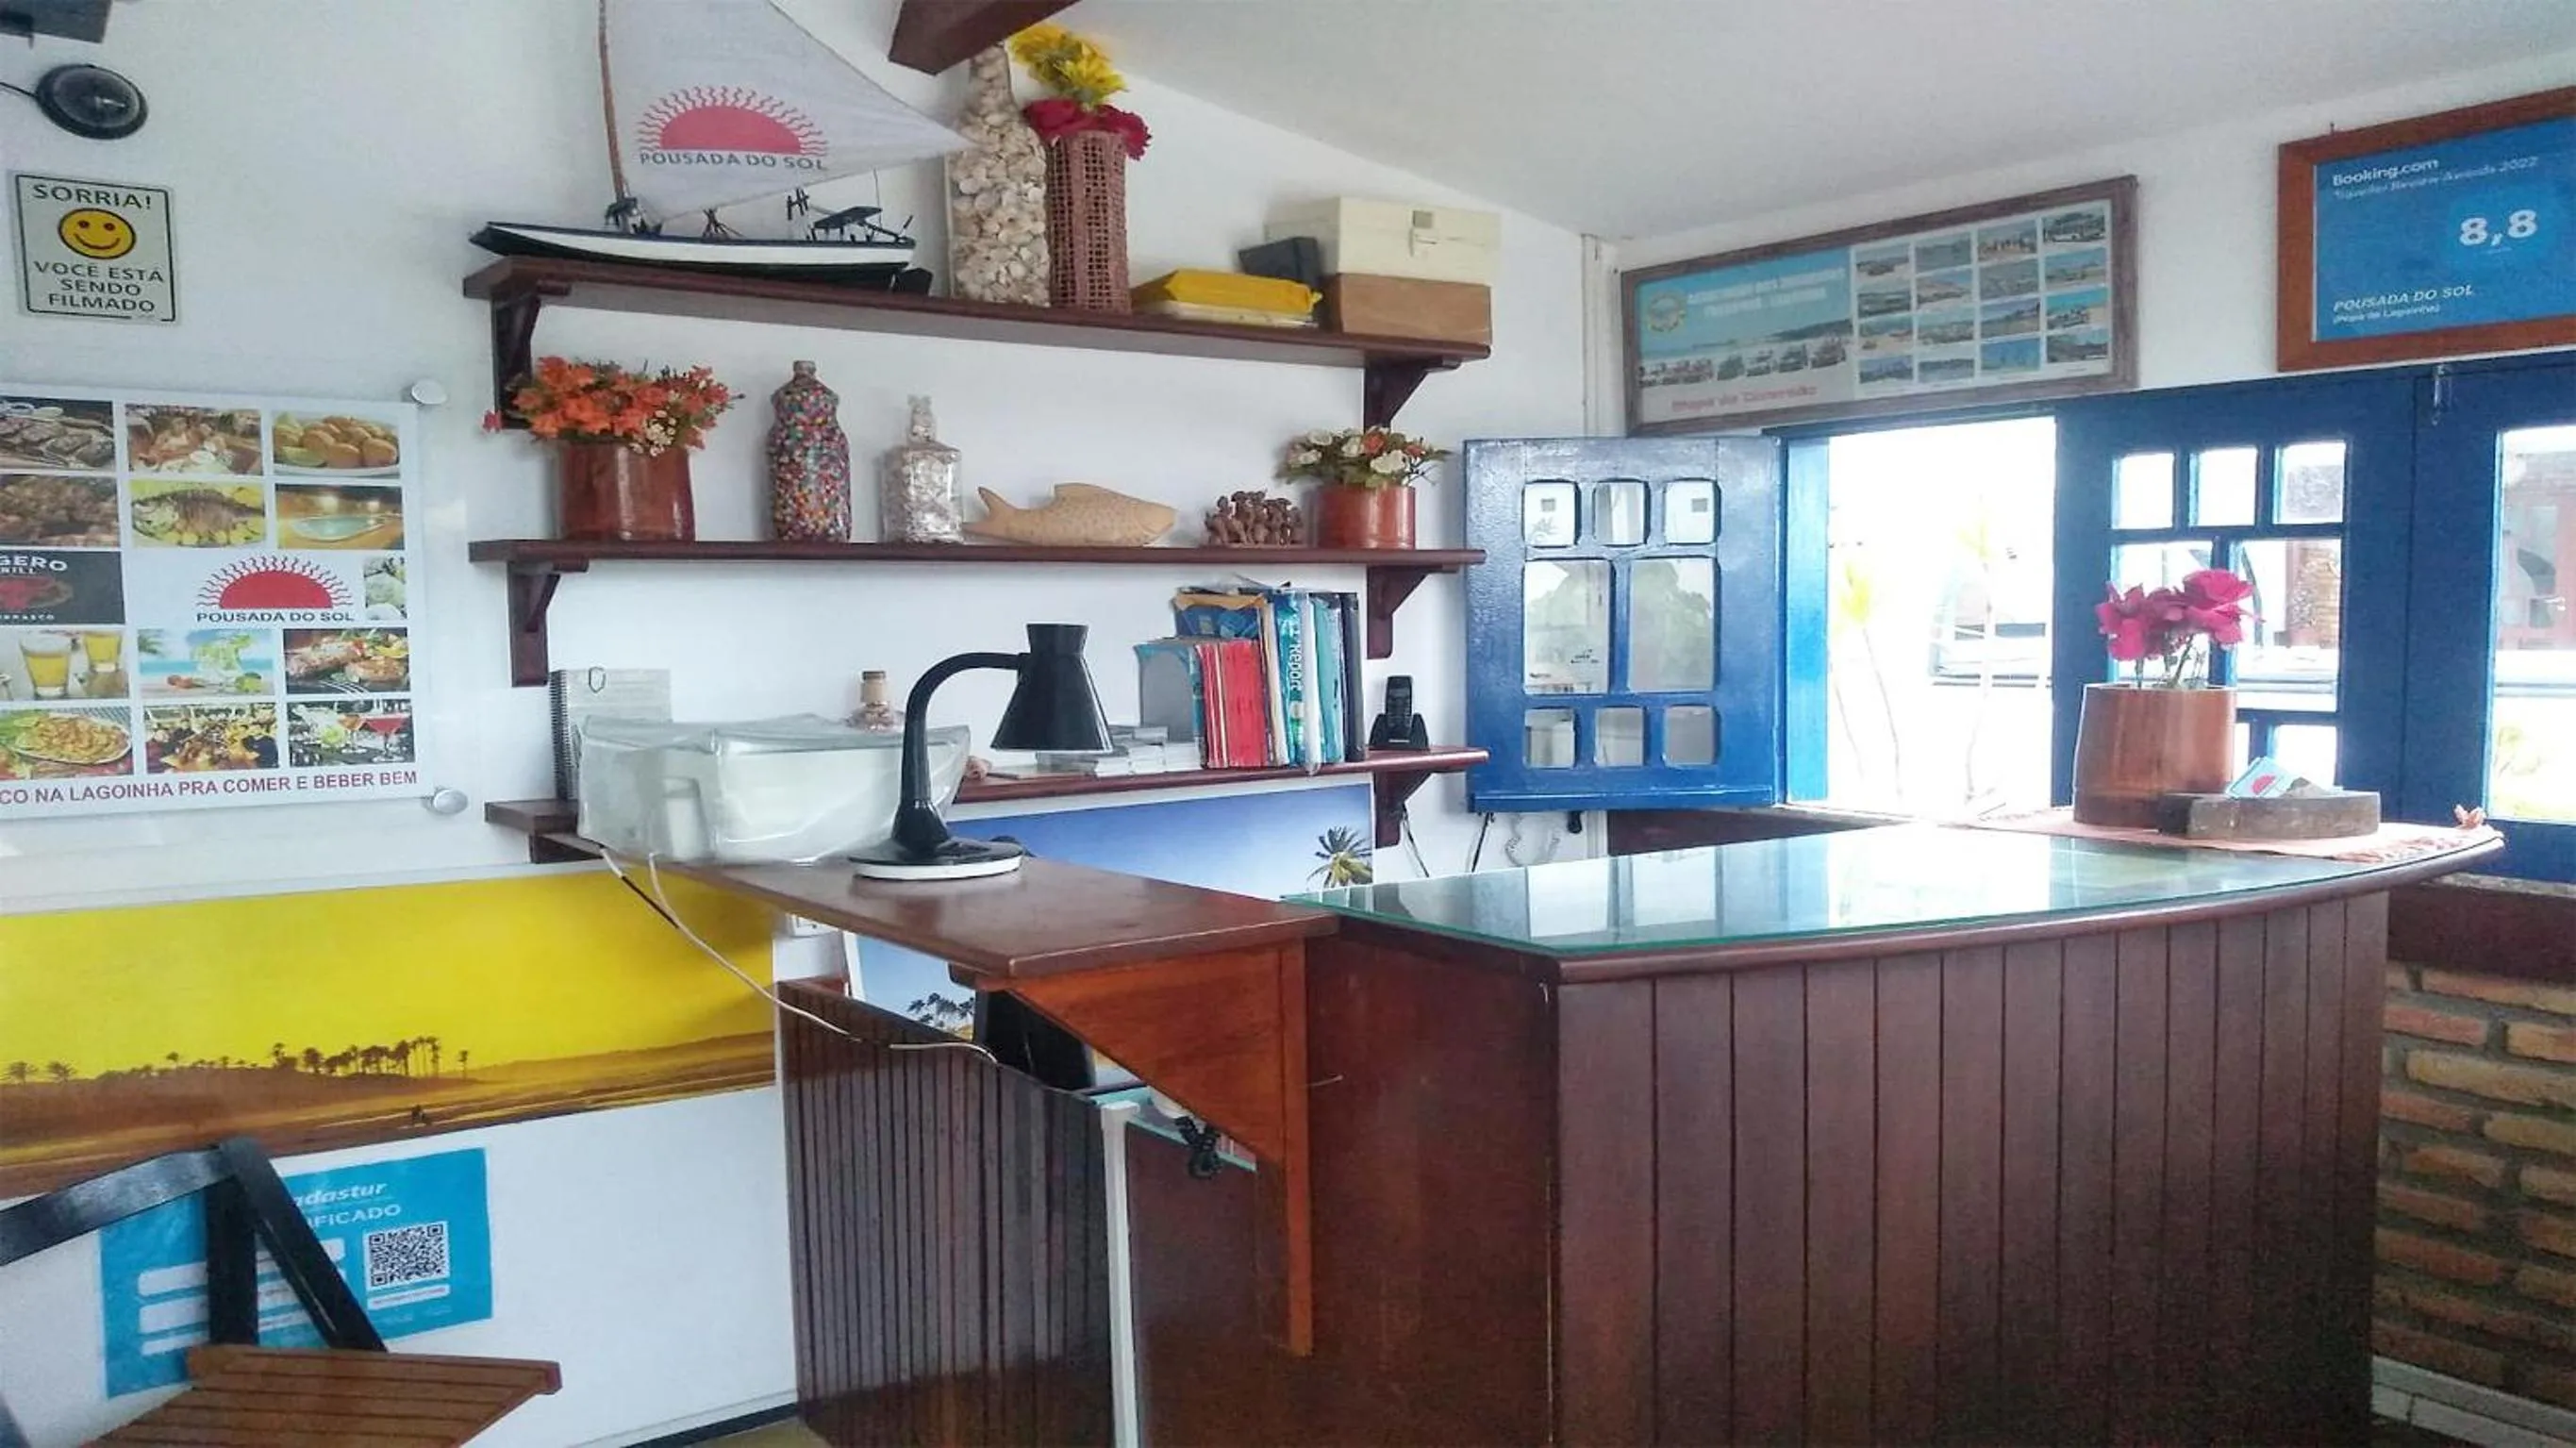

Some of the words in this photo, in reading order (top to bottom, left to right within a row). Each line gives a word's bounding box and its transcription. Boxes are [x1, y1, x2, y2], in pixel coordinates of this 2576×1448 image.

[640, 152, 741, 166] POUSADA
[745, 154, 777, 168] DO
[784, 156, 828, 170] SOL
[2333, 158, 2439, 187] Booking.com
[34, 184, 152, 210] SORRIA!
[2459, 208, 2538, 247] 8,8
[59, 278, 141, 296] SENDO
[2333, 293, 2409, 313] POUSADA
[2414, 290, 2438, 302] DO
[2442, 284, 2473, 299] SOL
[48, 293, 156, 312] FILMADO
[196, 612, 286, 623] POUSADA
[290, 612, 315, 623] DO
[320, 612, 356, 623] SOL
[35, 787, 64, 803] NA
[69, 782, 175, 802] LAGOINHA
[177, 780, 219, 796] PRA
[223, 776, 291, 794] COMER
[296, 775, 308, 790] E
[313, 773, 375, 790] BEBER
[379, 771, 418, 786] BEM
[293, 1182, 389, 1207] adastur
[307, 1203, 402, 1227] IFICADO
